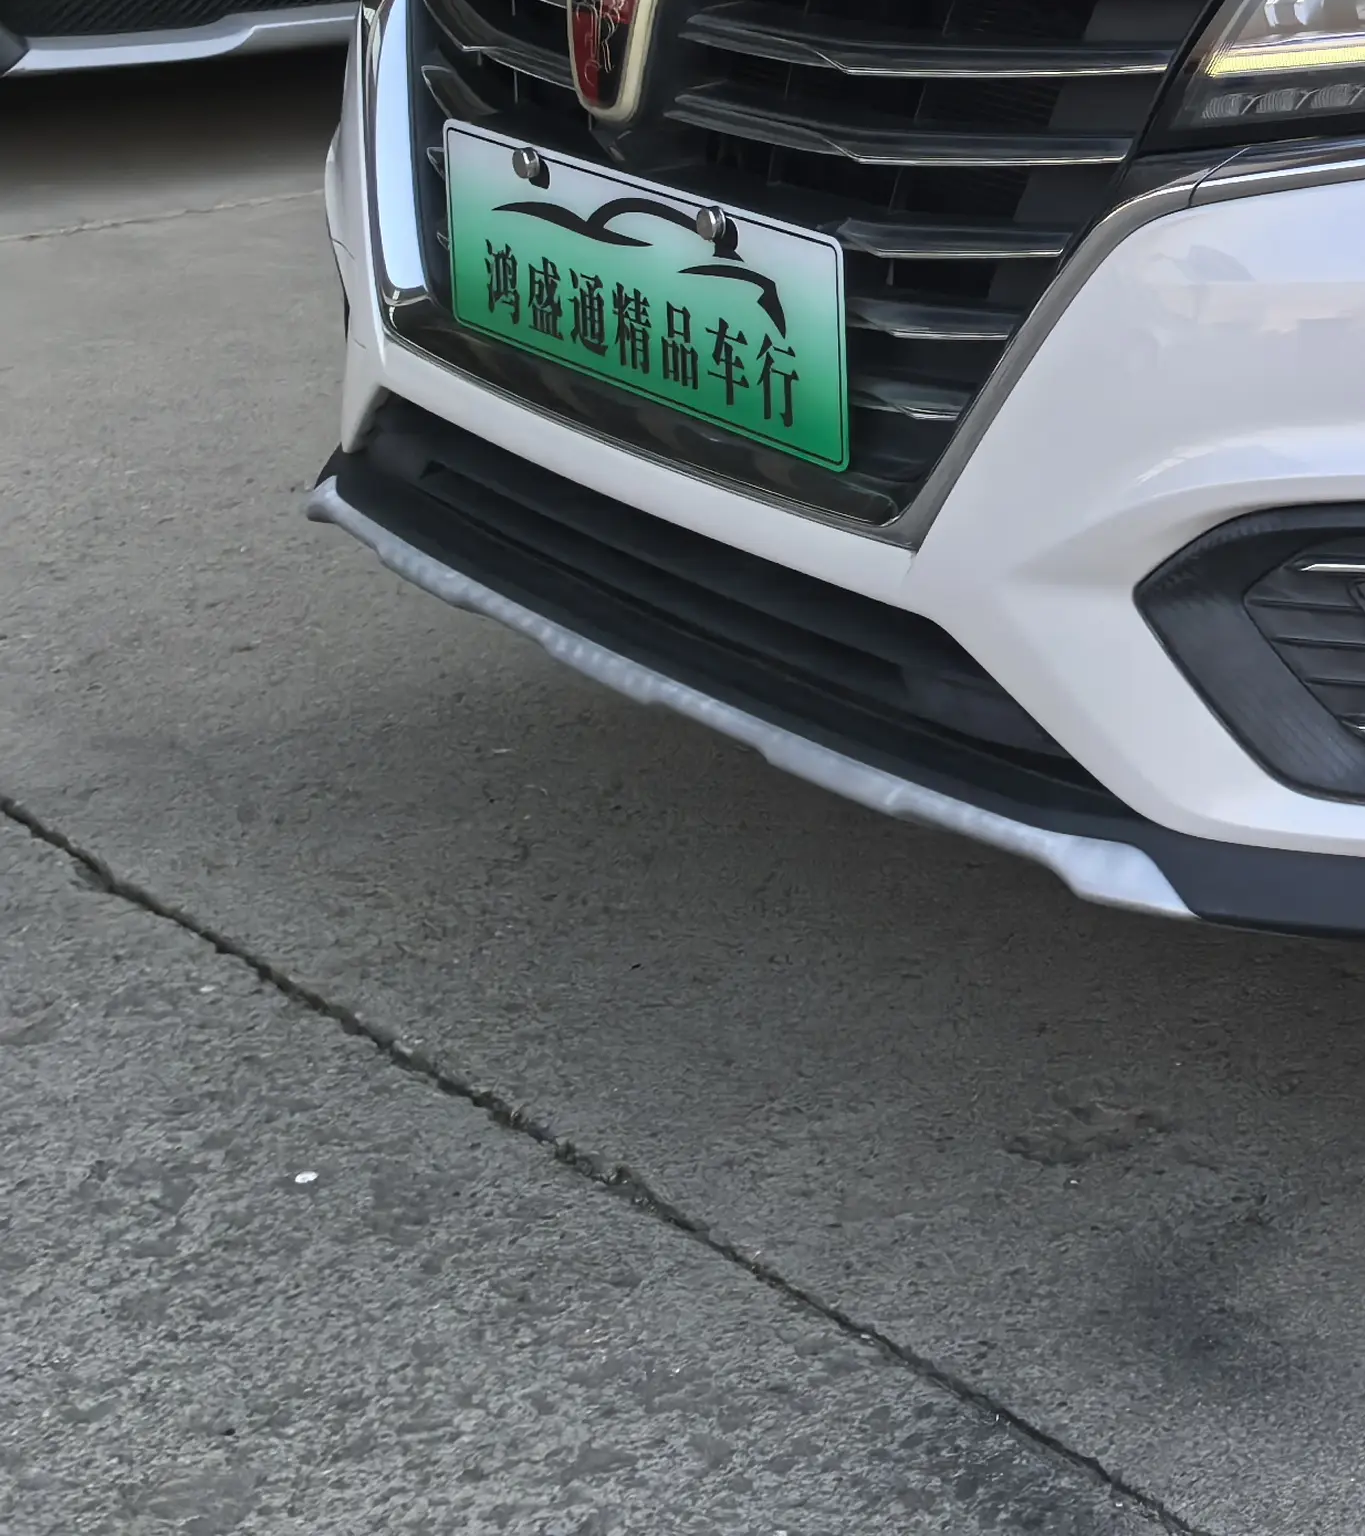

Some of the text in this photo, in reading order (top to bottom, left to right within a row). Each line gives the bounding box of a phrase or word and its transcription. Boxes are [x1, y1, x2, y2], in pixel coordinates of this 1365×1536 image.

[484, 238, 799, 428] 鸿盛通精品车行
